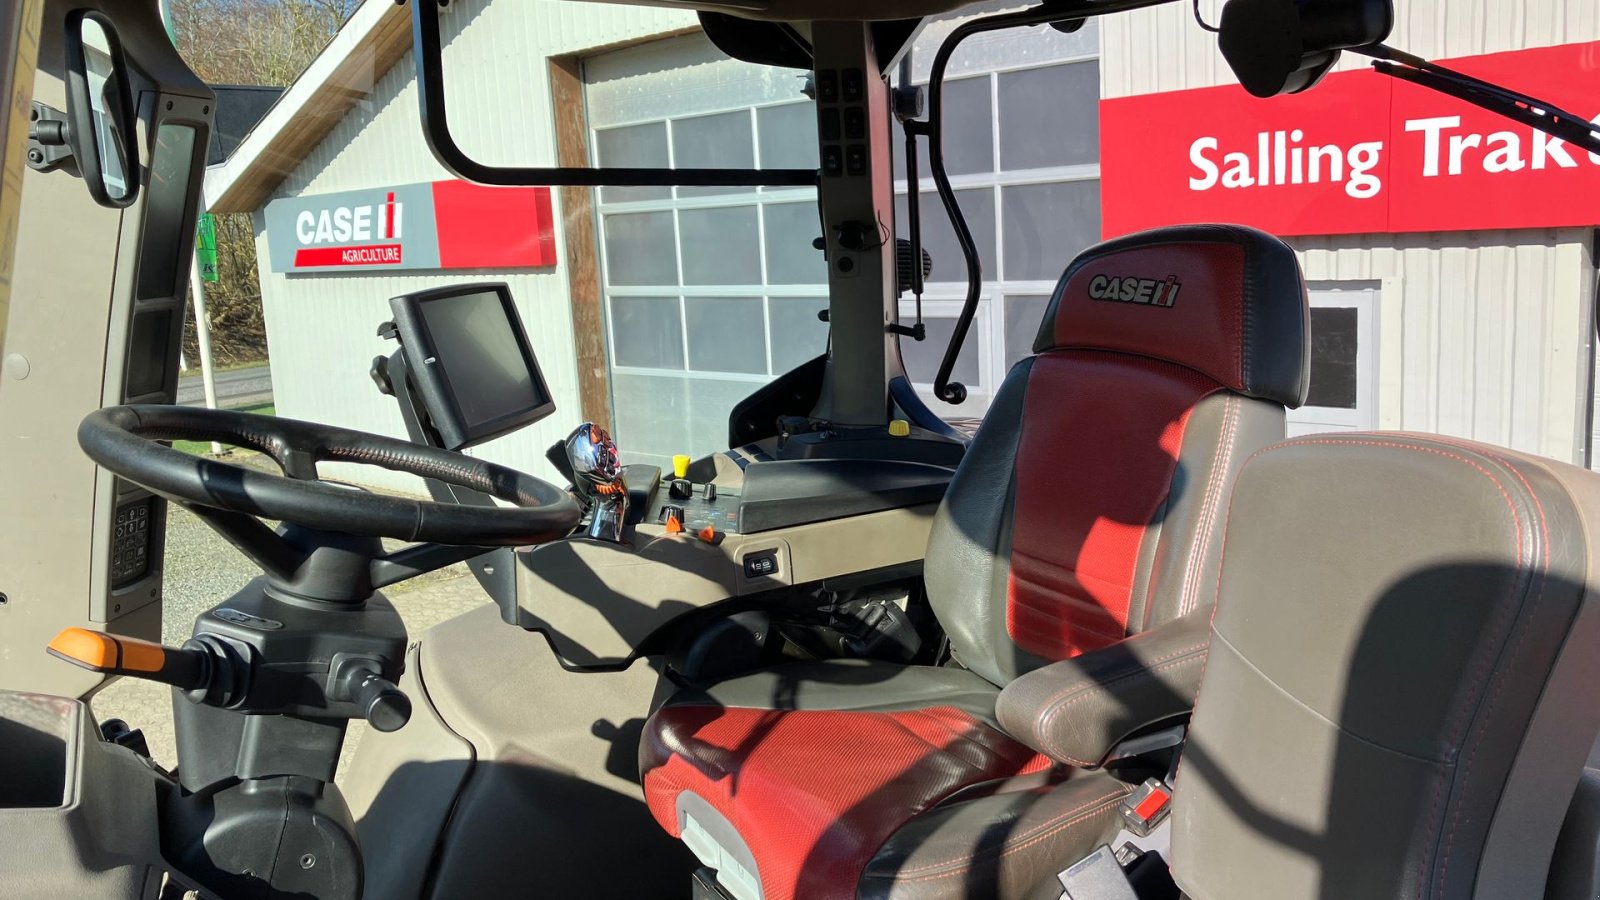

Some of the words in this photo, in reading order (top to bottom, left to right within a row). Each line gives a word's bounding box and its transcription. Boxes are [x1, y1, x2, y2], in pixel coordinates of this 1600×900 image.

[1189, 129, 1384, 199] Salling
[296, 206, 372, 245] CASE
[342, 247, 400, 263] AGRICULTURE
[1088, 274, 1155, 303] CASE
